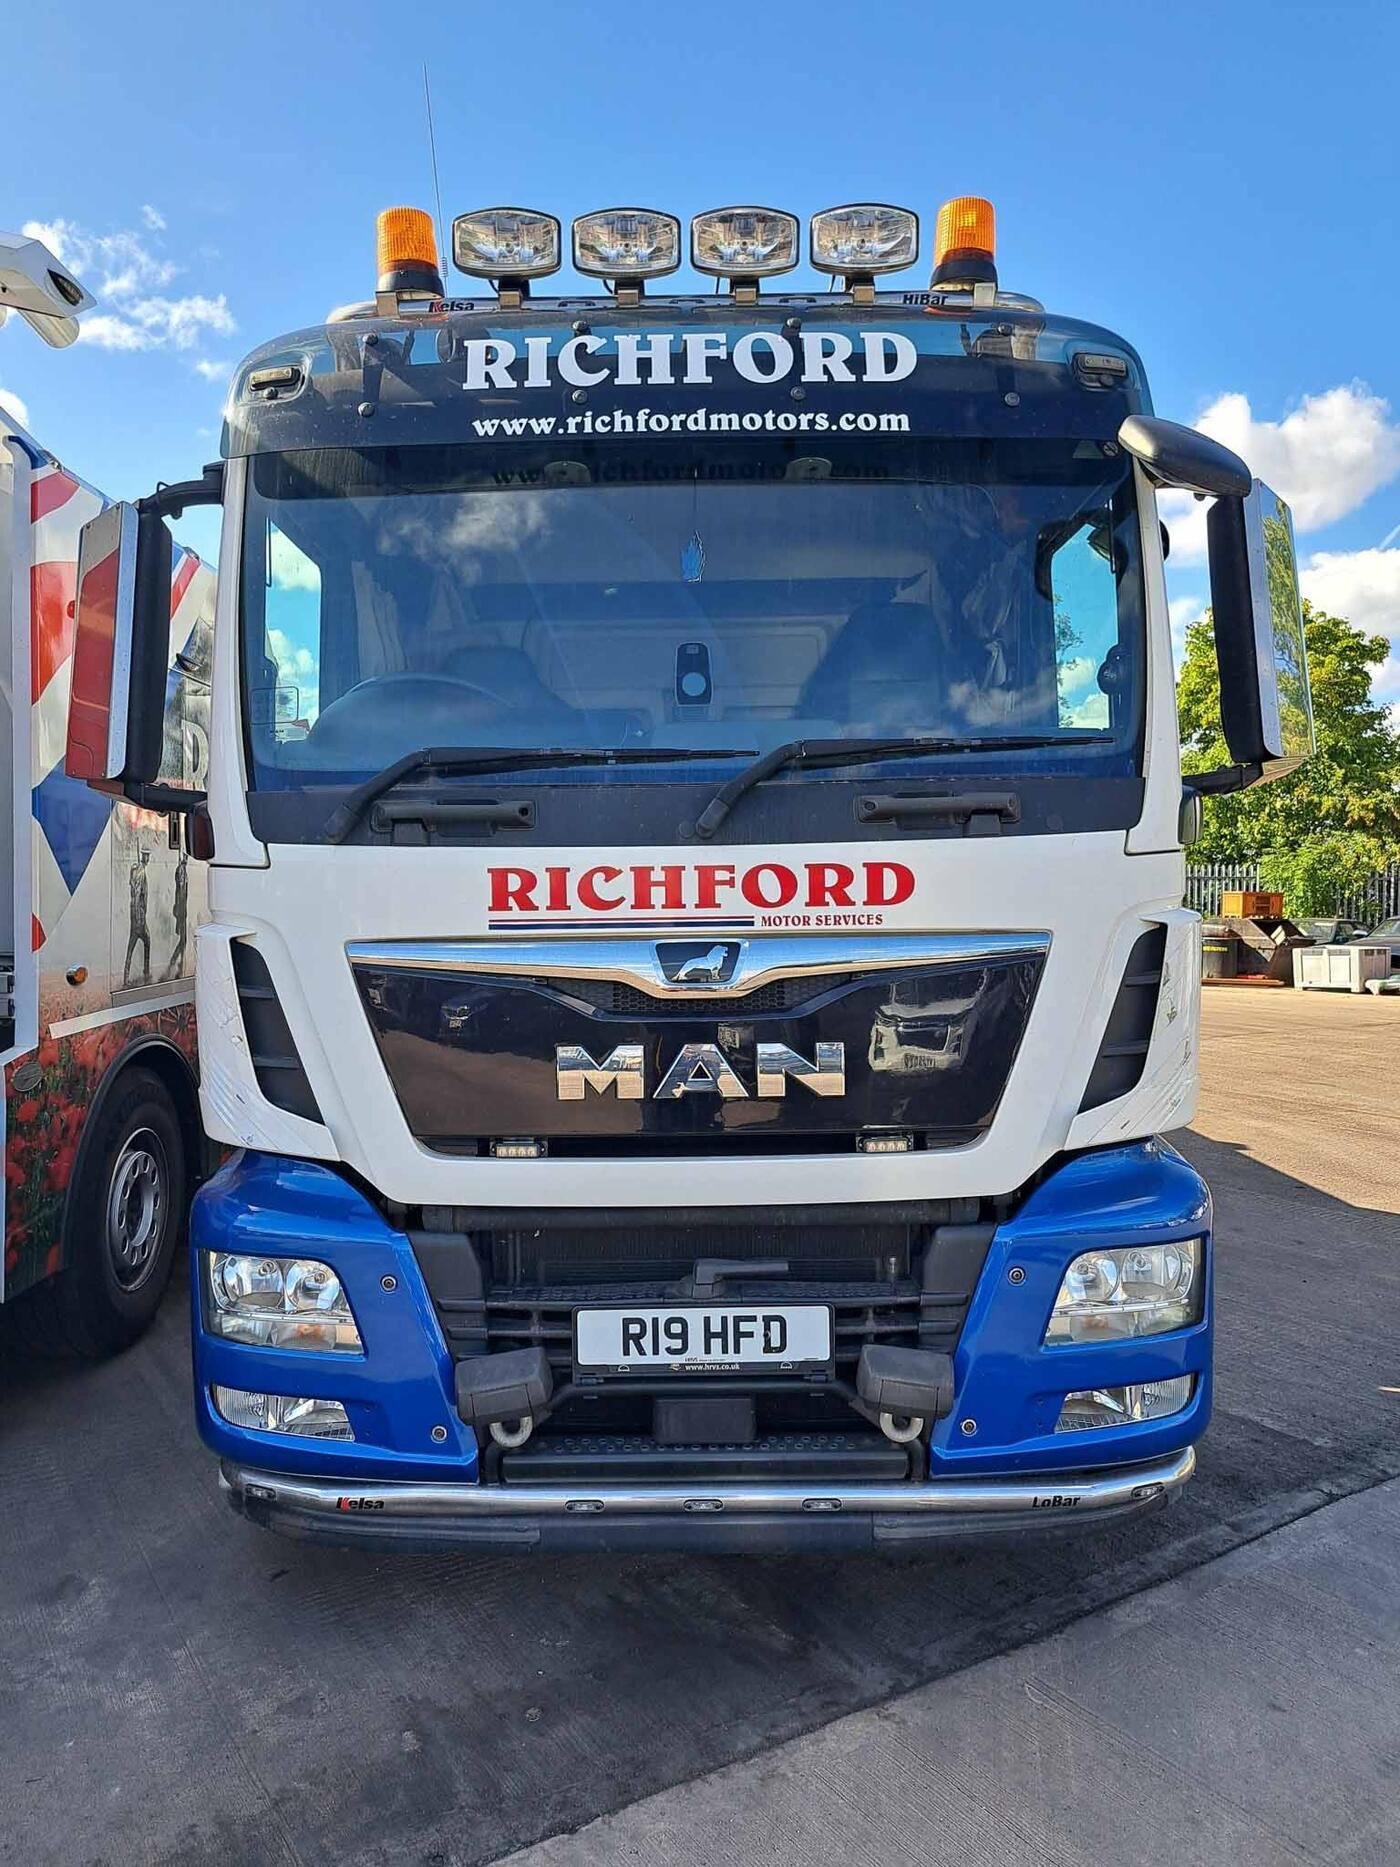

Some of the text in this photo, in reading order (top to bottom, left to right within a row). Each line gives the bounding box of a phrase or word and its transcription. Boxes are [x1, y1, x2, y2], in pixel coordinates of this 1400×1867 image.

[429, 301, 475, 312] Kelsa
[903, 293, 948, 305] HiBar
[462, 331, 918, 390] RICHFORD
[472, 408, 911, 437] www.richfordmotors.com
[487, 862, 916, 911] RICHFORD
[761, 913, 883, 927] MOTOR SERVICES
[556, 1041, 845, 1101] MAN
[622, 1314, 787, 1356] R19 HFD
[685, 1363, 740, 1371] www.hrvs.co.uk
[336, 1496, 385, 1511] Kelsa
[1032, 1495, 1081, 1508] LoBar
